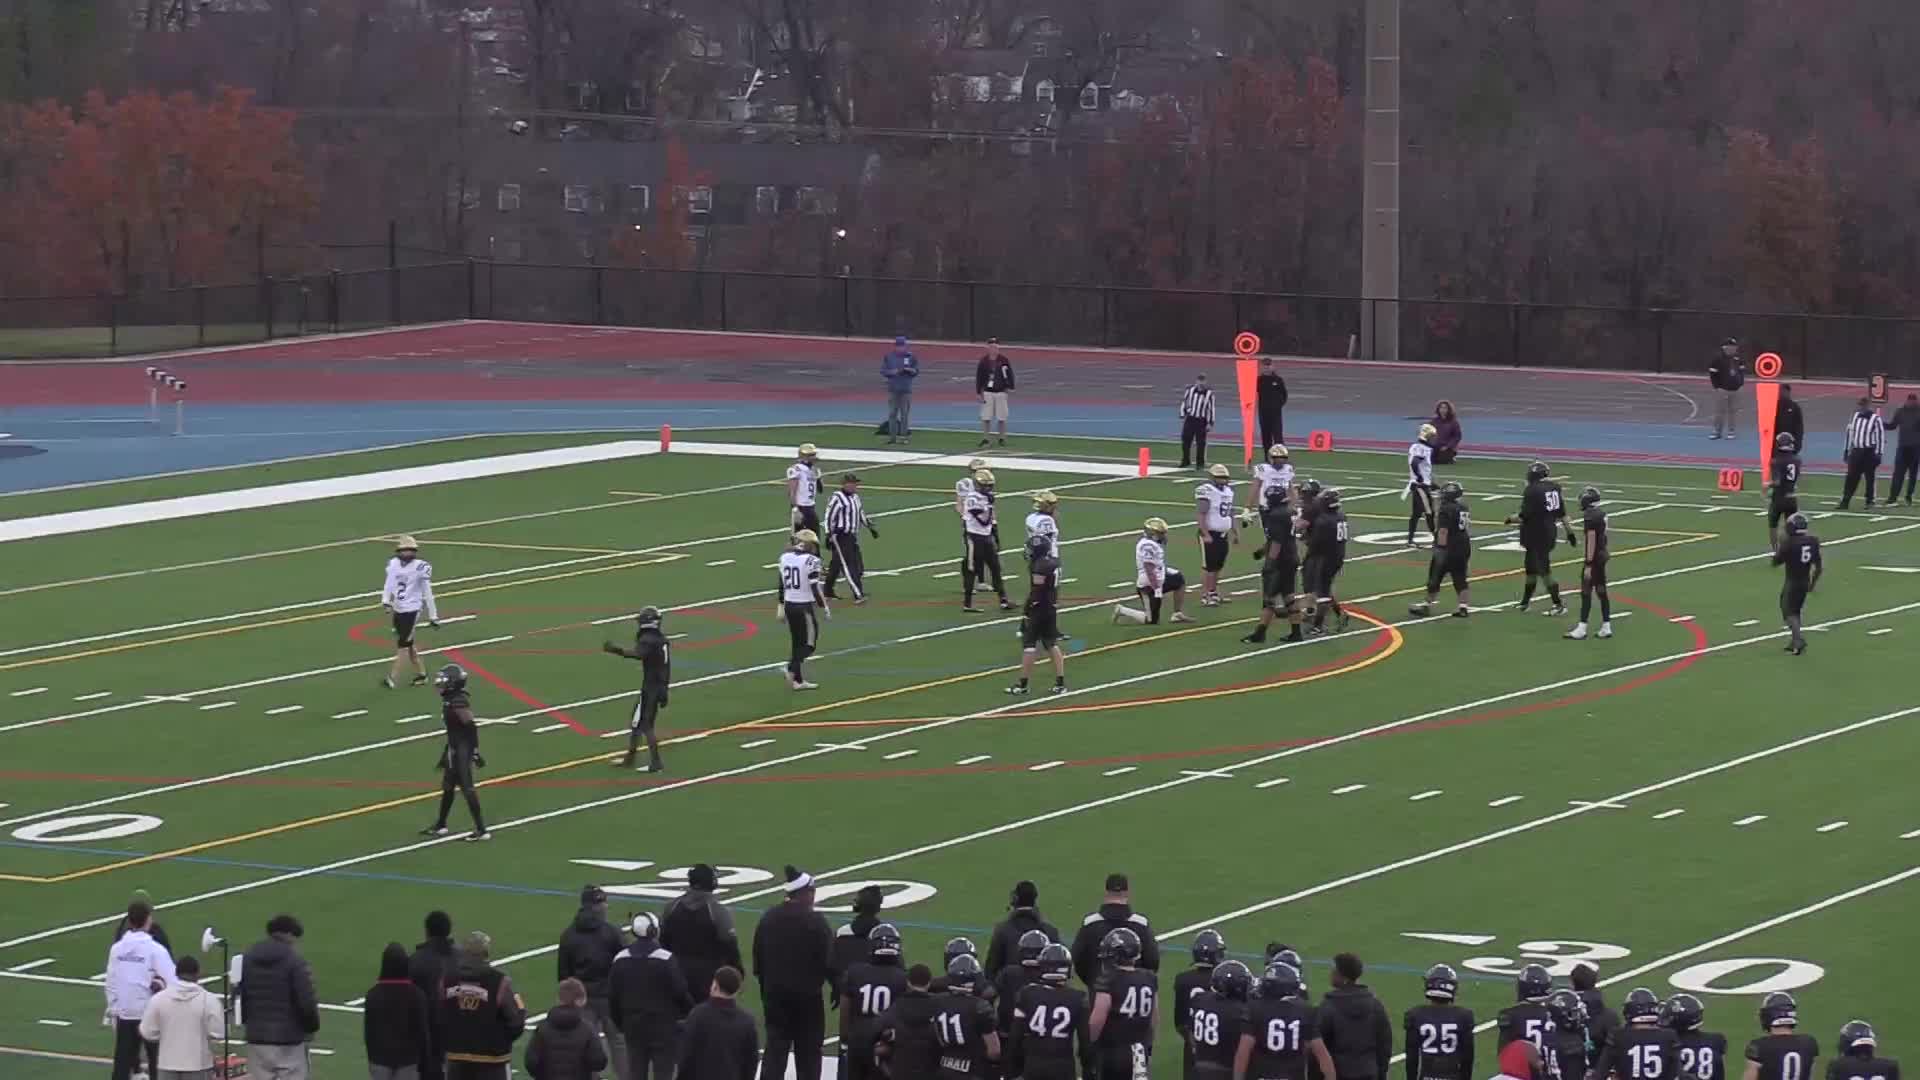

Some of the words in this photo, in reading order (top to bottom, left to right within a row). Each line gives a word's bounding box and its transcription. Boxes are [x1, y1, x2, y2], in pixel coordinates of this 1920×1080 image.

[1315, 433, 1325, 447] G
[1721, 470, 1739, 487] 10
[1786, 464, 1796, 480] 3
[1544, 490, 1560, 512] 50
[397, 581, 407, 600] 2
[783, 566, 801, 590] 20
[662, 643, 669, 664] 1
[858, 983, 892, 1015] 10
[1119, 985, 1153, 1019] 46
[937, 1012, 966, 1045] 11
[1029, 1005, 1072, 1038] 42
[1193, 1009, 1220, 1046] 68
[1266, 1018, 1301, 1051] 61
[1419, 1023, 1459, 1054] 25
[1627, 1044, 1662, 1079] 15
[1678, 1047, 1714, 1080] 28
